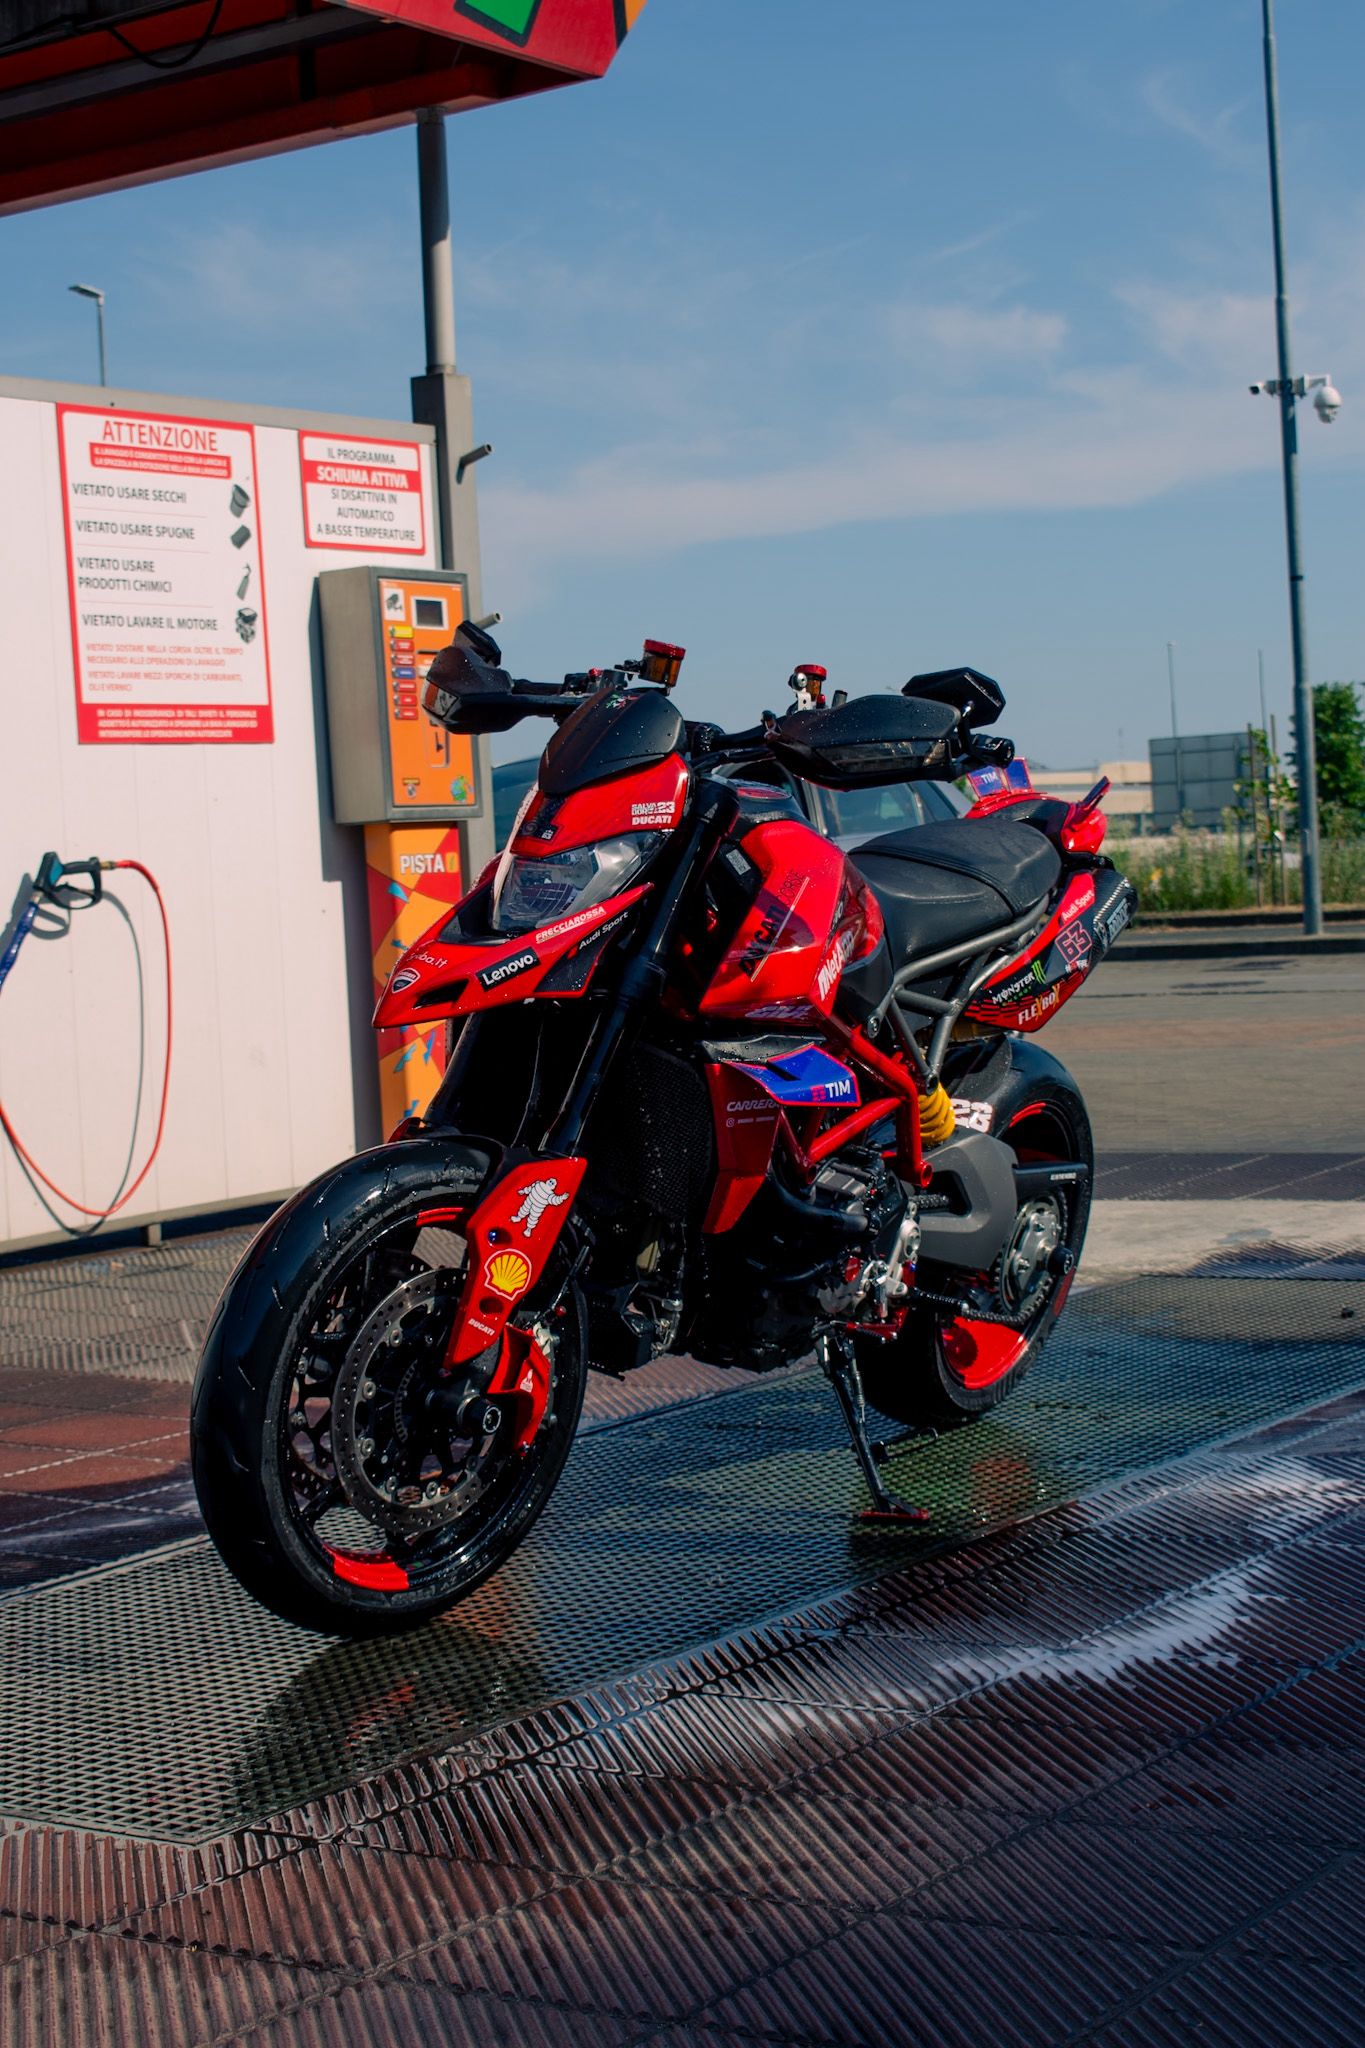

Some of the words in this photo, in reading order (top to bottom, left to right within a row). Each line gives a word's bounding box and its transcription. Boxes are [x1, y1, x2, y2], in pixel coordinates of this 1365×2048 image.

[103, 420, 218, 451] ATTENZIONE
[327, 447, 335, 459] IL
[337, 448, 395, 464] PROGRAMMA
[316, 465, 369, 485] SCHIUMA
[370, 471, 408, 489] ATTIVA
[72, 483, 115, 497] VIETATO
[117, 486, 149, 501] USARE
[152, 489, 187, 503] SECCHI
[331, 488, 339, 499] SI
[341, 489, 386, 504] DISATTIVA
[389, 494, 397, 504] IN
[337, 507, 394, 522] AUTOMATICO
[75, 520, 118, 534] VIETATO
[120, 523, 152, 537] USARE
[154, 525, 195, 540] SPUGNE
[317, 523, 323, 534] A
[325, 524, 352, 537] BASSE
[354, 526, 416, 541] TEMPERATURE
[77, 557, 119, 571] VIETATO
[122, 559, 155, 572] USARE
[78, 576, 132, 591] PRODOTTI
[133, 579, 172, 593] CHIMICI
[82, 613, 125, 628] VIETATO
[127, 616, 164, 629] LAVARE
[166, 617, 175, 629] IL
[177, 618, 218, 631] MOTORE
[86, 643, 113, 652] VIETATO
[147, 645, 166, 653] NELLA
[88, 671, 115, 680] VIETATO
[981, 771, 999, 785] TIM
[656, 801, 676, 814] 23
[632, 815, 672, 826] DUCATI
[400, 853, 446, 875] PISTA
[1062, 903, 1078, 921] Audi
[1074, 889, 1095, 908] Sport
[535, 906, 606, 942] FRECCIAROSSA
[579, 931, 601, 950] Audi
[602, 911, 629, 934] Sport
[738, 904, 787, 978] DUCATI
[1055, 920, 1093, 964] 63
[482, 954, 535, 986] Lenovo
[992, 972, 1036, 1005] MONSTER
[825, 1079, 851, 1099] TIM
[468, 1317, 496, 1337] DUCATI
